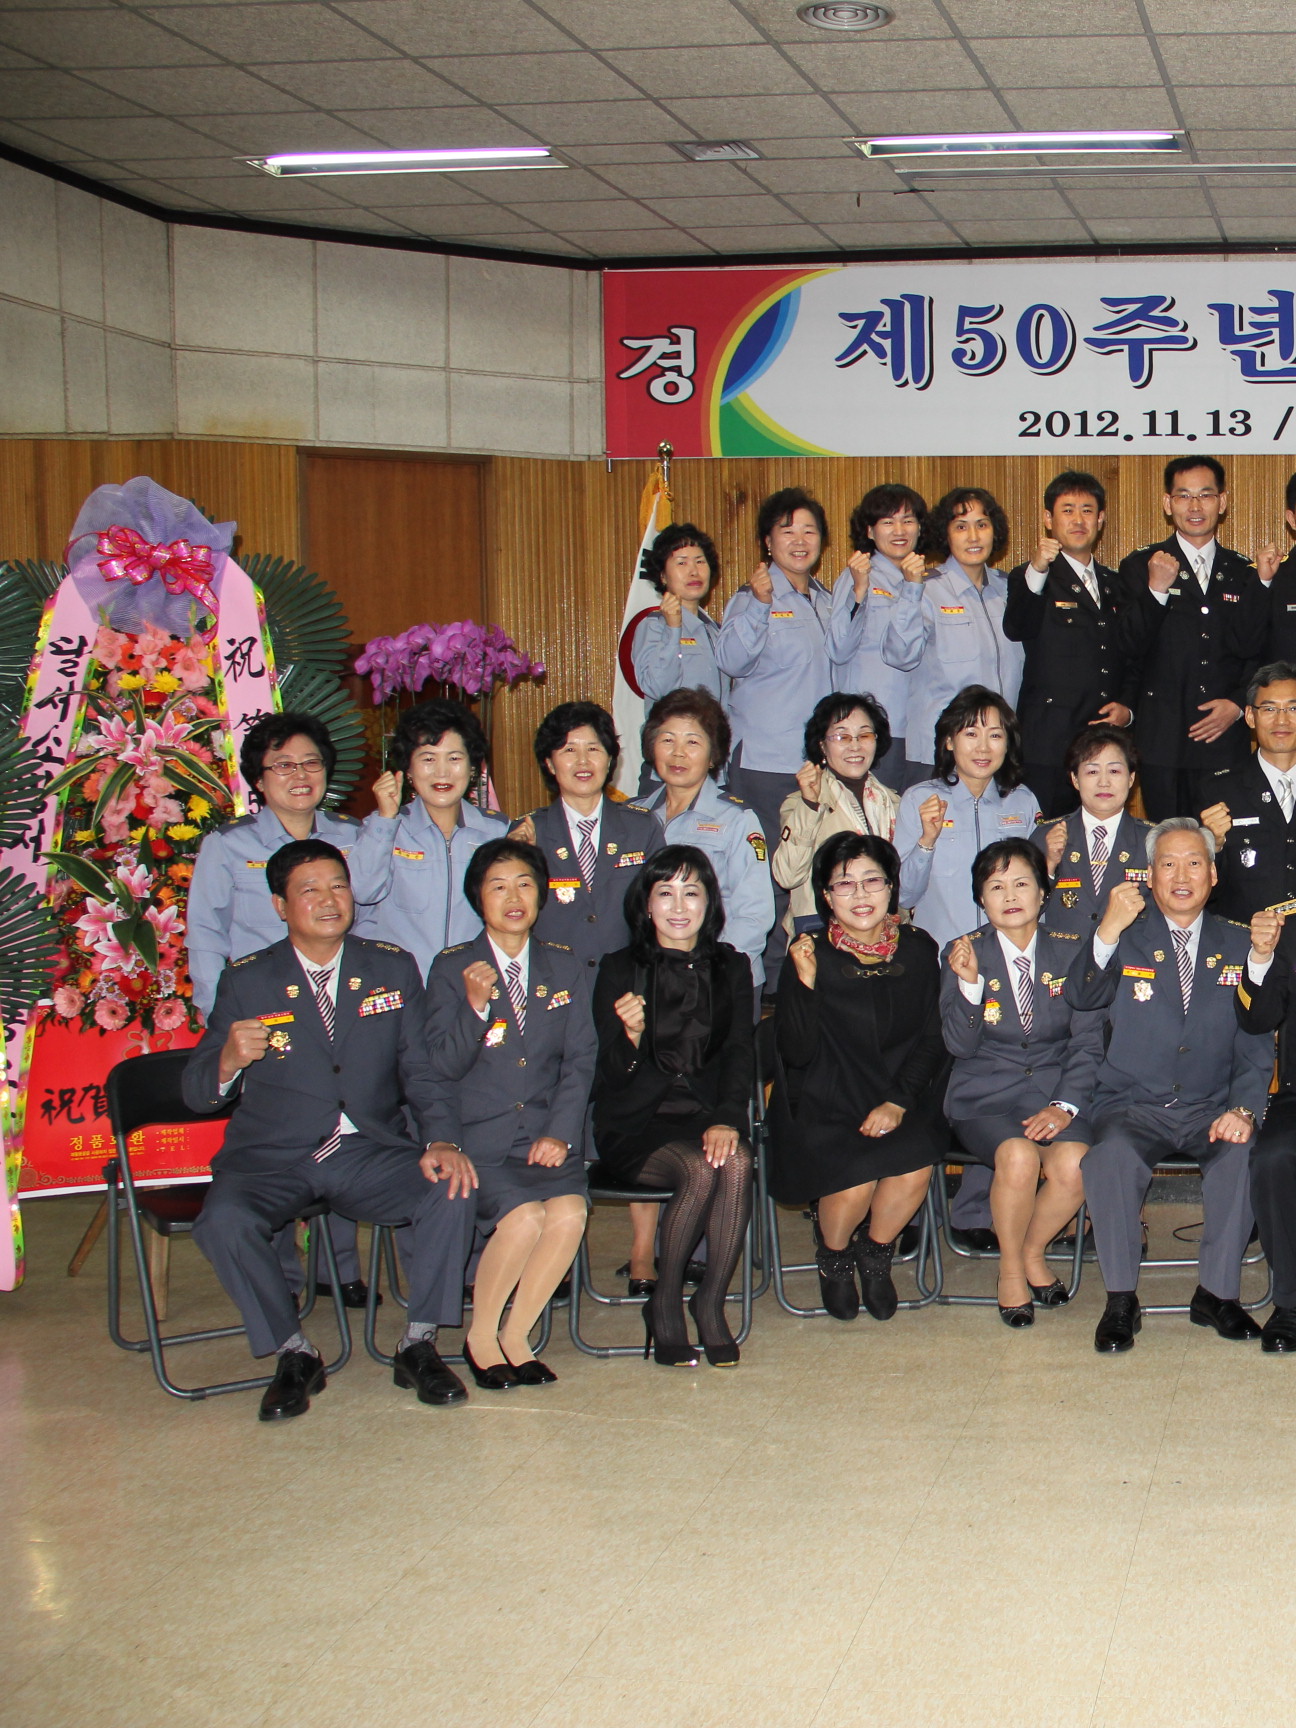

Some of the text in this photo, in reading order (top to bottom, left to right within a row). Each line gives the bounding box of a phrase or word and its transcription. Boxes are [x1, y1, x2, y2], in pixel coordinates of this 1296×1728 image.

[619, 326, 698, 403] 경
[1017, 409, 1253, 443] 2012.11.13
[224, 636, 266, 683] 祝
[5, 634, 93, 864] 달서소서
